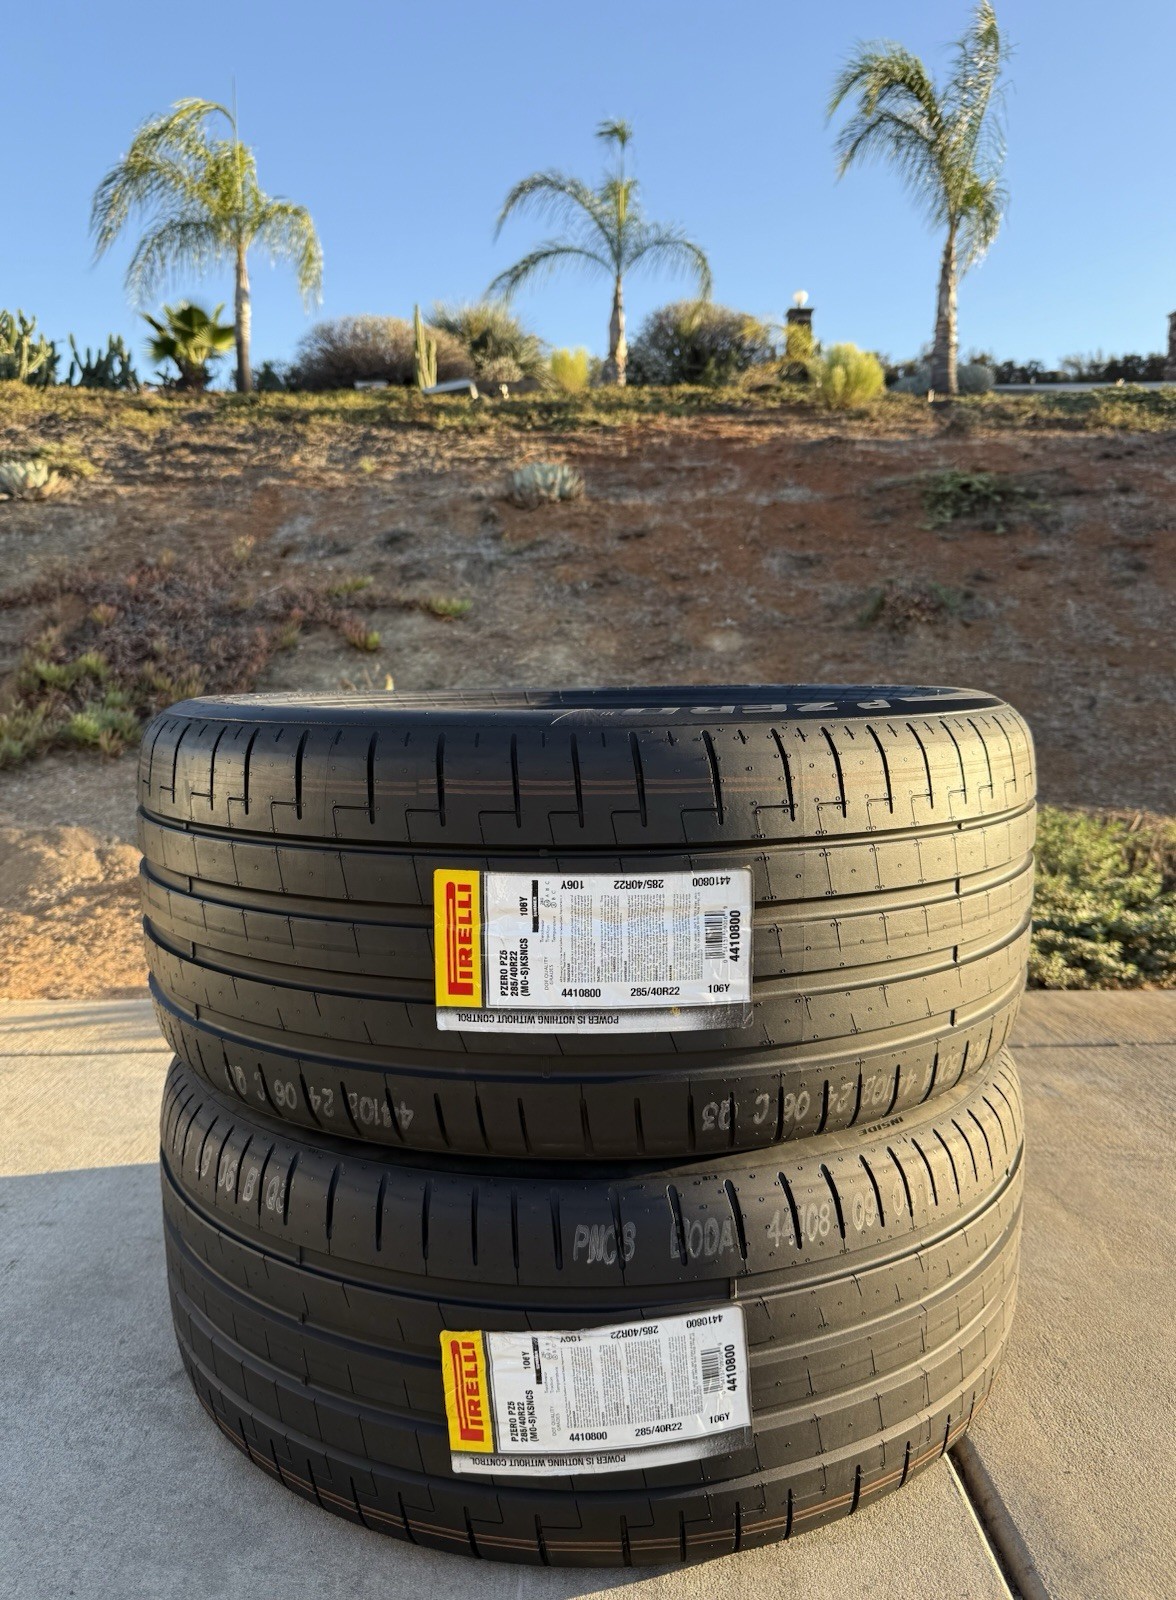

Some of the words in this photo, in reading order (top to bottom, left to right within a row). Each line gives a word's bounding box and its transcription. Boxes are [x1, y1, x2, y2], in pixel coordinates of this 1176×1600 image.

[620, 701, 839, 716] ZERO
[856, 699, 891, 710] P
[560, 880, 585, 890] 106Y
[613, 879, 664, 890] 285/40R22
[692, 876, 731, 887] 4410800
[446, 882, 474, 995] PIRELLI
[729, 910, 741, 962] 4410800
[499, 949, 508, 966] PZ5
[509, 950, 519, 997] 285/40R22
[500, 968, 509, 996] PZERO
[561, 988, 601, 998] 4410800
[630, 986, 680, 997] 285/40R22
[708, 983, 731, 993] 106Y
[456, 1013, 495, 1023] CONTROL
[496, 1014, 537, 1024] WITHOUT
[538, 1015, 576, 1024] NOTHING
[577, 1016, 586, 1025] IS
[589, 1015, 619, 1025] POWER
[857, 1116, 904, 1137] INSIDE
[686, 1314, 723, 1328] 4410800
[610, 1325, 659, 1339] 285/40R22
[724, 1344, 738, 1392] 4410800
[450, 1339, 485, 1443] PIRELLI
[507, 1401, 516, 1417] PZ5
[517, 1401, 528, 1442] 285/40R22
[709, 1412, 731, 1424] 106Y
[508, 1417, 519, 1442] PZERO
[634, 1422, 683, 1437] 285/40R22
[569, 1431, 608, 1441] 4410800
[470, 1457, 507, 1467] CONTROL
[508, 1458, 546, 1467] WITHOUT
[547, 1457, 584, 1467] NOTHING
[586, 1457, 595, 1465] IS
[596, 1454, 626, 1465] POWER
